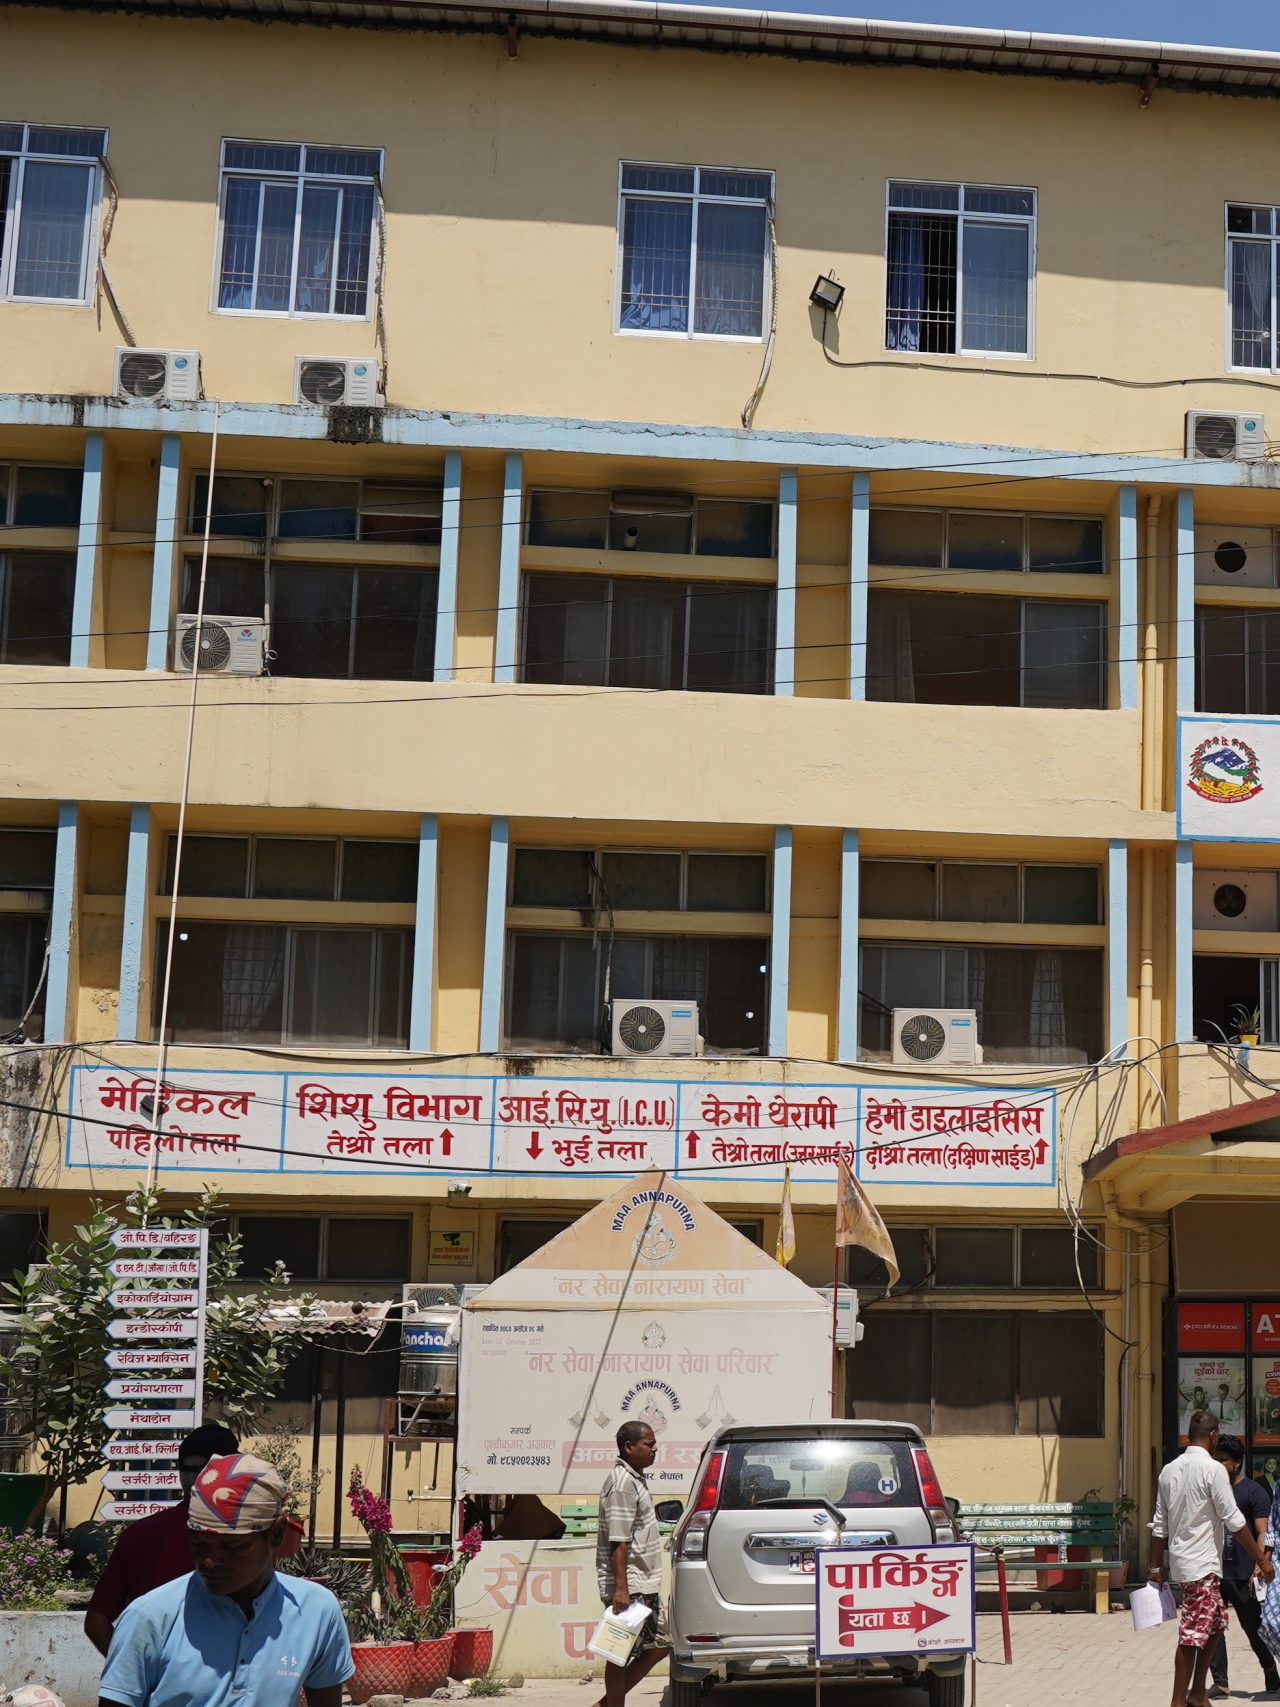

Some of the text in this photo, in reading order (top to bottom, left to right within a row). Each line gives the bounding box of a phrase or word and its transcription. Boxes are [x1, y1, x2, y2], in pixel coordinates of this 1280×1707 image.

[296, 1083, 483, 1131] शिशु विभाग
[701, 1093, 838, 1131] केमो थेरापी
[866, 1097, 1044, 1137] हेमो डाइलाइसिस
[190, 1133, 240, 1155] तला
[326, 1130, 434, 1158] तेश्रो तला
[552, 1135, 647, 1166] भुई तला
[610, 1189, 698, 1234] MAA ANNAPURNA
[126, 1321, 183, 1334] इन्डोस्कोपी
[678, 1347, 710, 1376] सेवा
[121, 1382, 184, 1394] प्रयोगशाला
[620, 1379, 681, 1413] MAA ANNAPURNA
[130, 1412, 172, 1424] मेथाडोन
[156, 1442, 180, 1454] क्लिनि
[121, 1472, 178, 1485] सर्जरी ओटी
[660, 1471, 684, 1481] नेपाल
[881, 1480, 893, 1491] H
[114, 1503, 147, 1515] सर्जरी
[790, 1555, 800, 1568] H
[484, 1553, 583, 1609] सेवा
[849, 1611, 885, 1628] यता
[893, 1611, 911, 1626] छ
